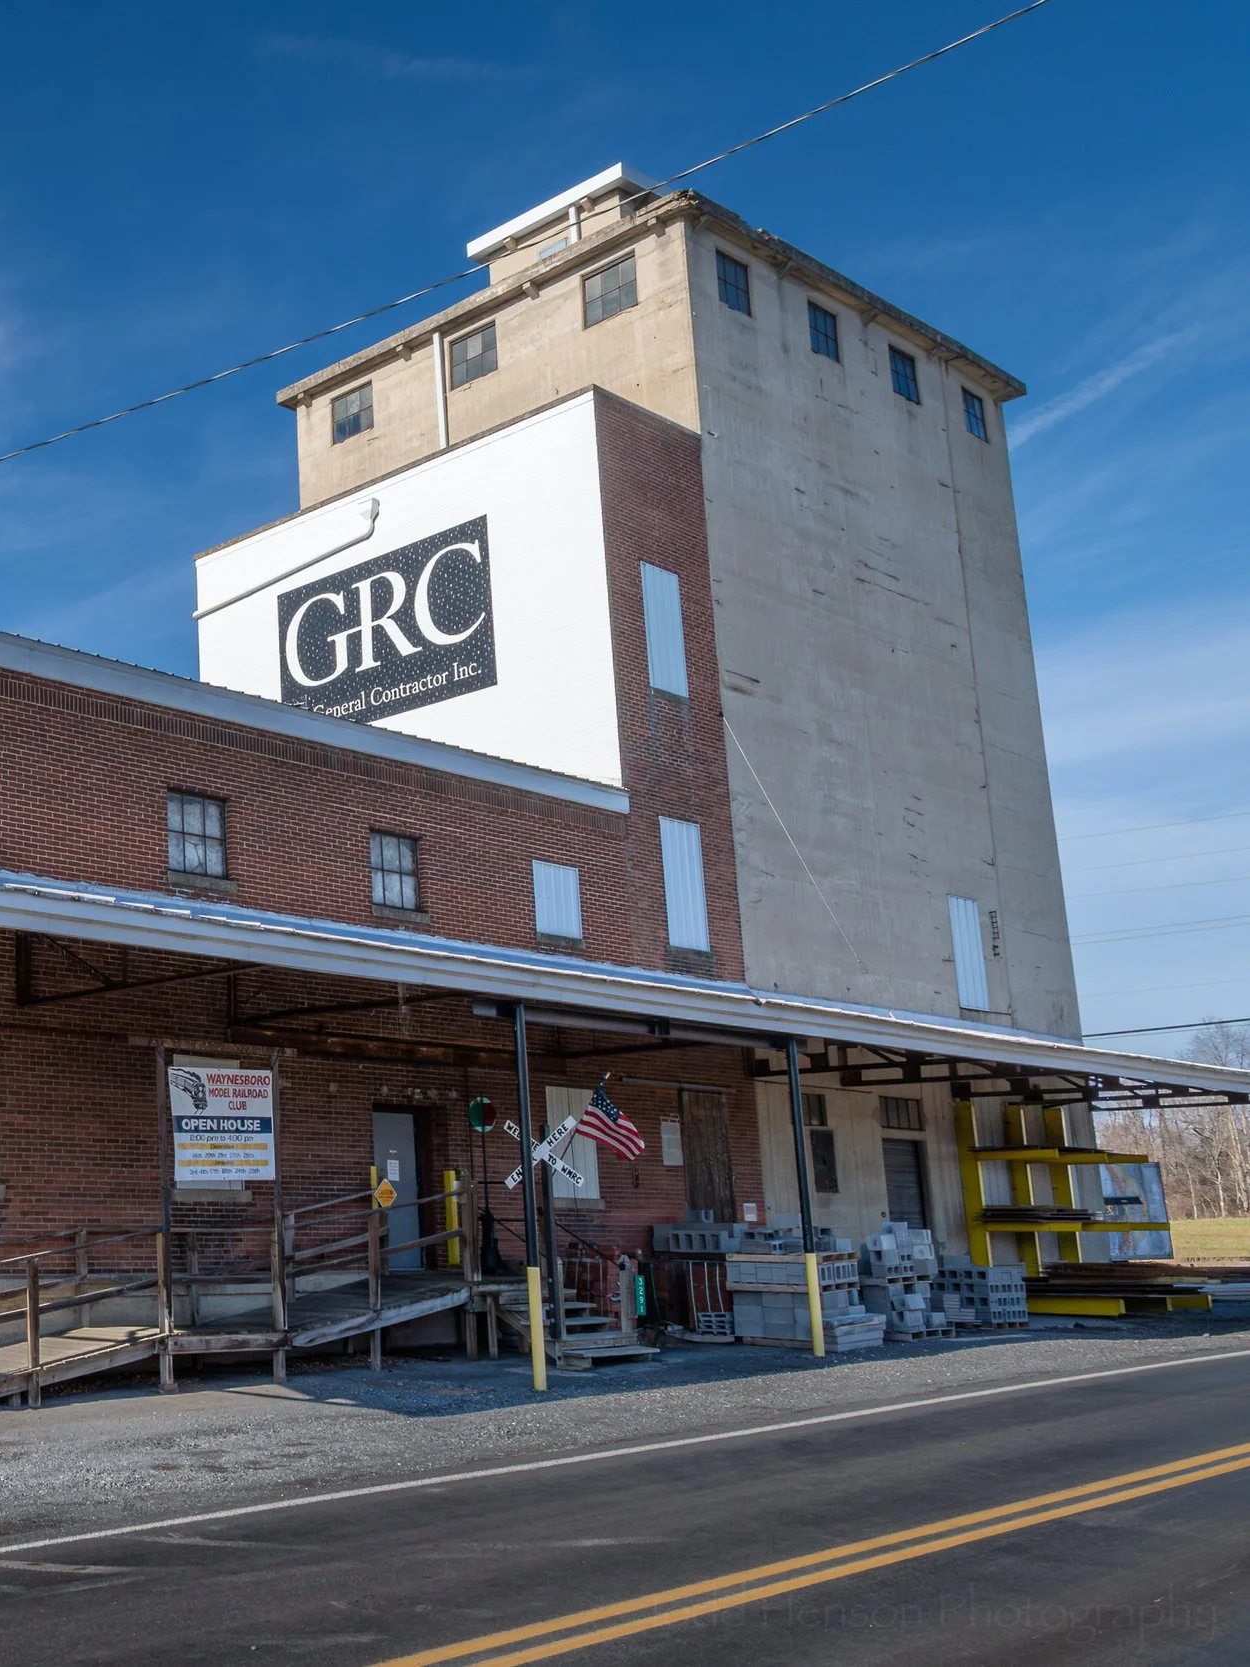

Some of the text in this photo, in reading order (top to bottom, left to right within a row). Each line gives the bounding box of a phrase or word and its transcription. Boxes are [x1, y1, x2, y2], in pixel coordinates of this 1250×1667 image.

[285, 540, 486, 687] GRC
[371, 672, 448, 706] Contractor
[453, 662, 482, 680] Inc.
[206, 1073, 270, 1086] WAYNESBORO
[209, 1088, 269, 1099] MODEL RAILROAD
[228, 1101, 247, 1110] CLUB
[181, 1118, 261, 1131] OPEN HOUSE
[546, 1123, 569, 1147] HERE
[547, 1154, 557, 1166] TO
[561, 1165, 582, 1184] WMRC
